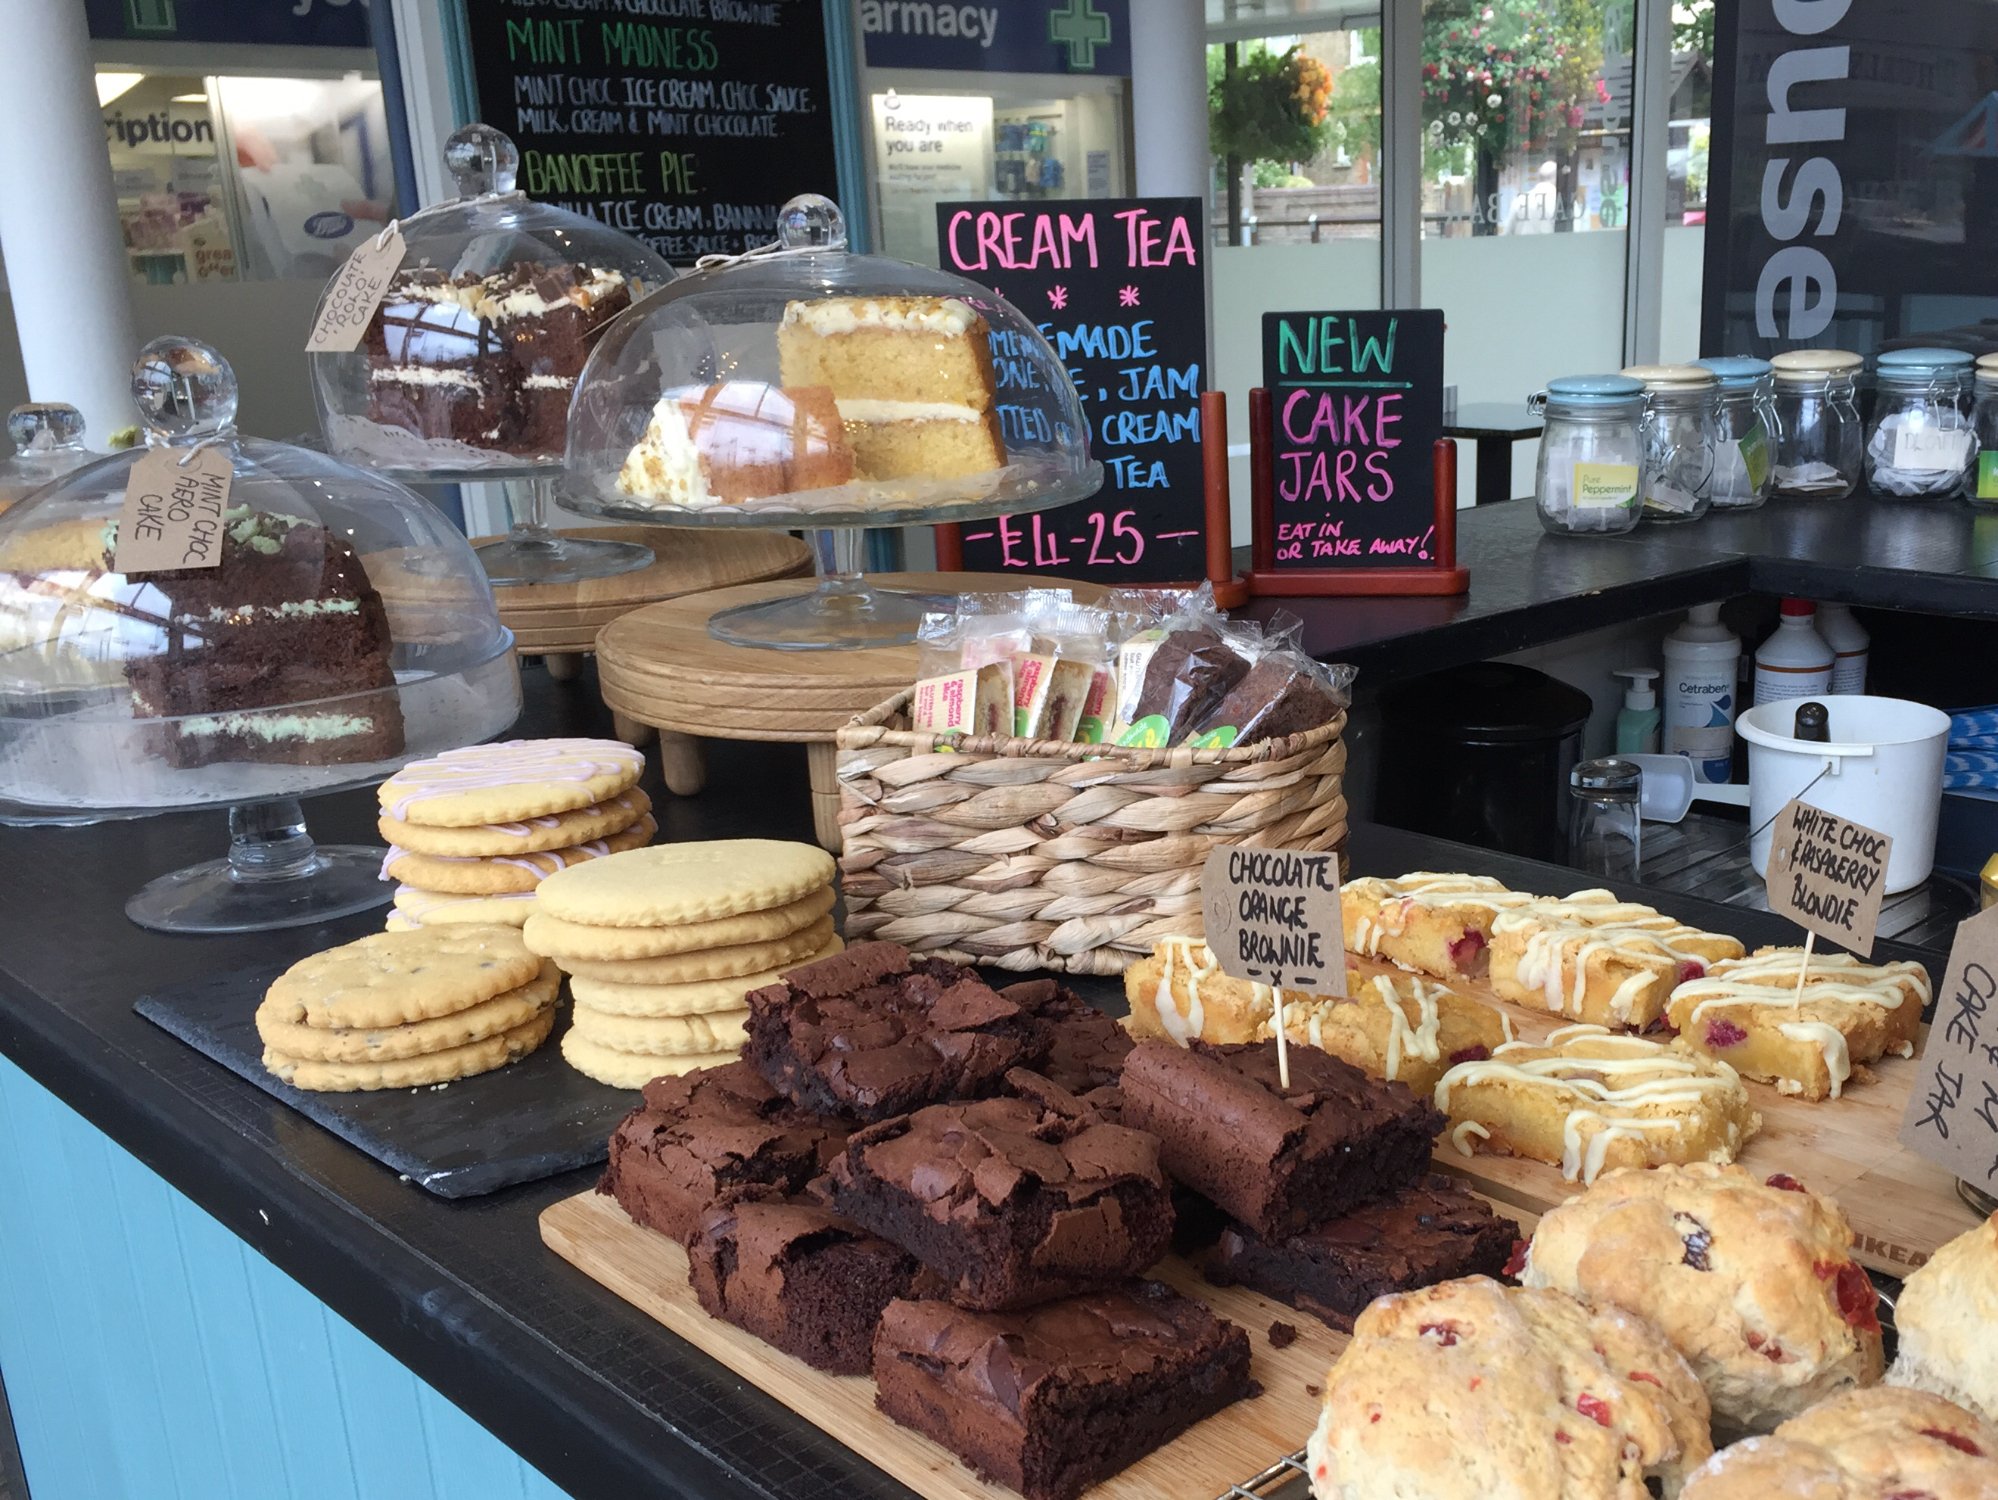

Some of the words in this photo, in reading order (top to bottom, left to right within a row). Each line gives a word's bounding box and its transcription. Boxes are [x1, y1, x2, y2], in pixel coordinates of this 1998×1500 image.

[506, 18, 584, 65] MINT
[601, 22, 719, 71] MADNESS
[514, 74, 564, 105] MINT
[568, 77, 618, 106] CHOC
[622, 77, 657, 107] ICE
[721, 81, 764, 112] CHOC
[570, 109, 625, 134] CREAM
[647, 110, 690, 135] MINT
[885, 116, 930, 135] Ready
[937, 119, 974, 132] when
[887, 140, 914, 156] you
[919, 140, 944, 152] are
[525, 150, 648, 194] BANOFFEE
[949, 210, 1098, 270] CREAM
[1114, 209, 1196, 267] TEA
[314, 251, 367, 344] CHOCOLATE
[351, 277, 382, 326] CAKE
[1279, 316, 1399, 374] NEW
[1118, 364, 1199, 401] JAM
[1102, 407, 1201, 445] CREAM
[1282, 390, 1404, 449] CAKE
[1105, 454, 1171, 489] TEA
[1279, 450, 1395, 503] JARS
[1582, 484, 1632, 495] Peppermint
[1583, 474, 1601, 484] Pure
[167, 475, 200, 522] AERO
[198, 472, 226, 518] MINT
[134, 494, 165, 541] CAKE
[1277, 522, 1317, 541] EAT
[182, 519, 217, 564] CHOC
[1276, 542, 1303, 560] OR
[1311, 538, 1362, 558] TAKE
[1679, 682, 1726, 694] Cetraben
[1840, 825, 1885, 865] CHOC
[1229, 851, 1334, 891] CHOCOLATE
[1800, 839, 1880, 896] RASPBERRY
[1239, 889, 1308, 931] ORANGE
[1239, 928, 1325, 969] BROWNIE
[1946, 963, 1997, 1054] CAKE
[1915, 1060, 1963, 1139] JAR
[1853, 1231, 1935, 1268] IKEA
